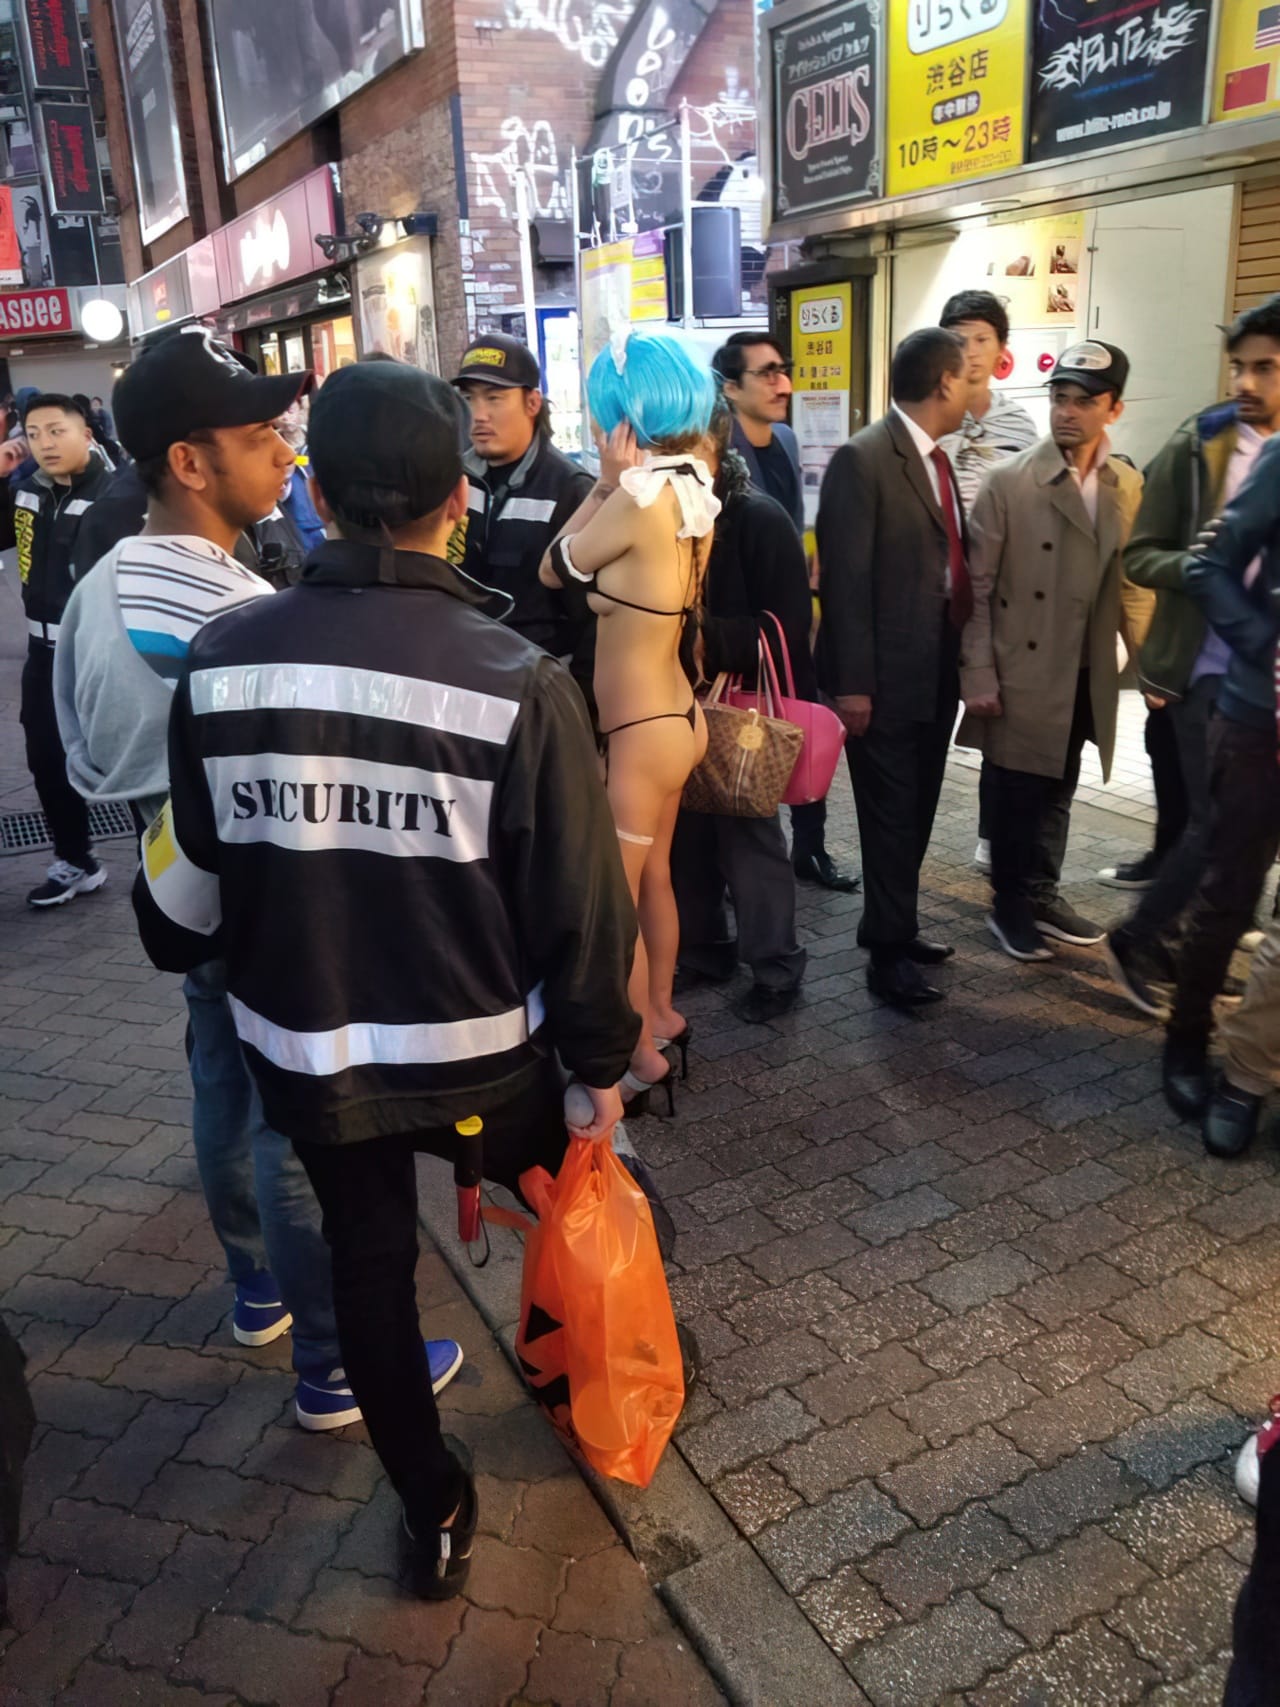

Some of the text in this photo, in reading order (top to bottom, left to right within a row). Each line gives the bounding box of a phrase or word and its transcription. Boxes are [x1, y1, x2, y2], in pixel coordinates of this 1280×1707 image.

[926, 48, 990, 95] 渋谷店
[786, 63, 871, 161] CELTS
[801, 304, 841, 327] りらくる
[231, 778, 457, 838] SECURITY
